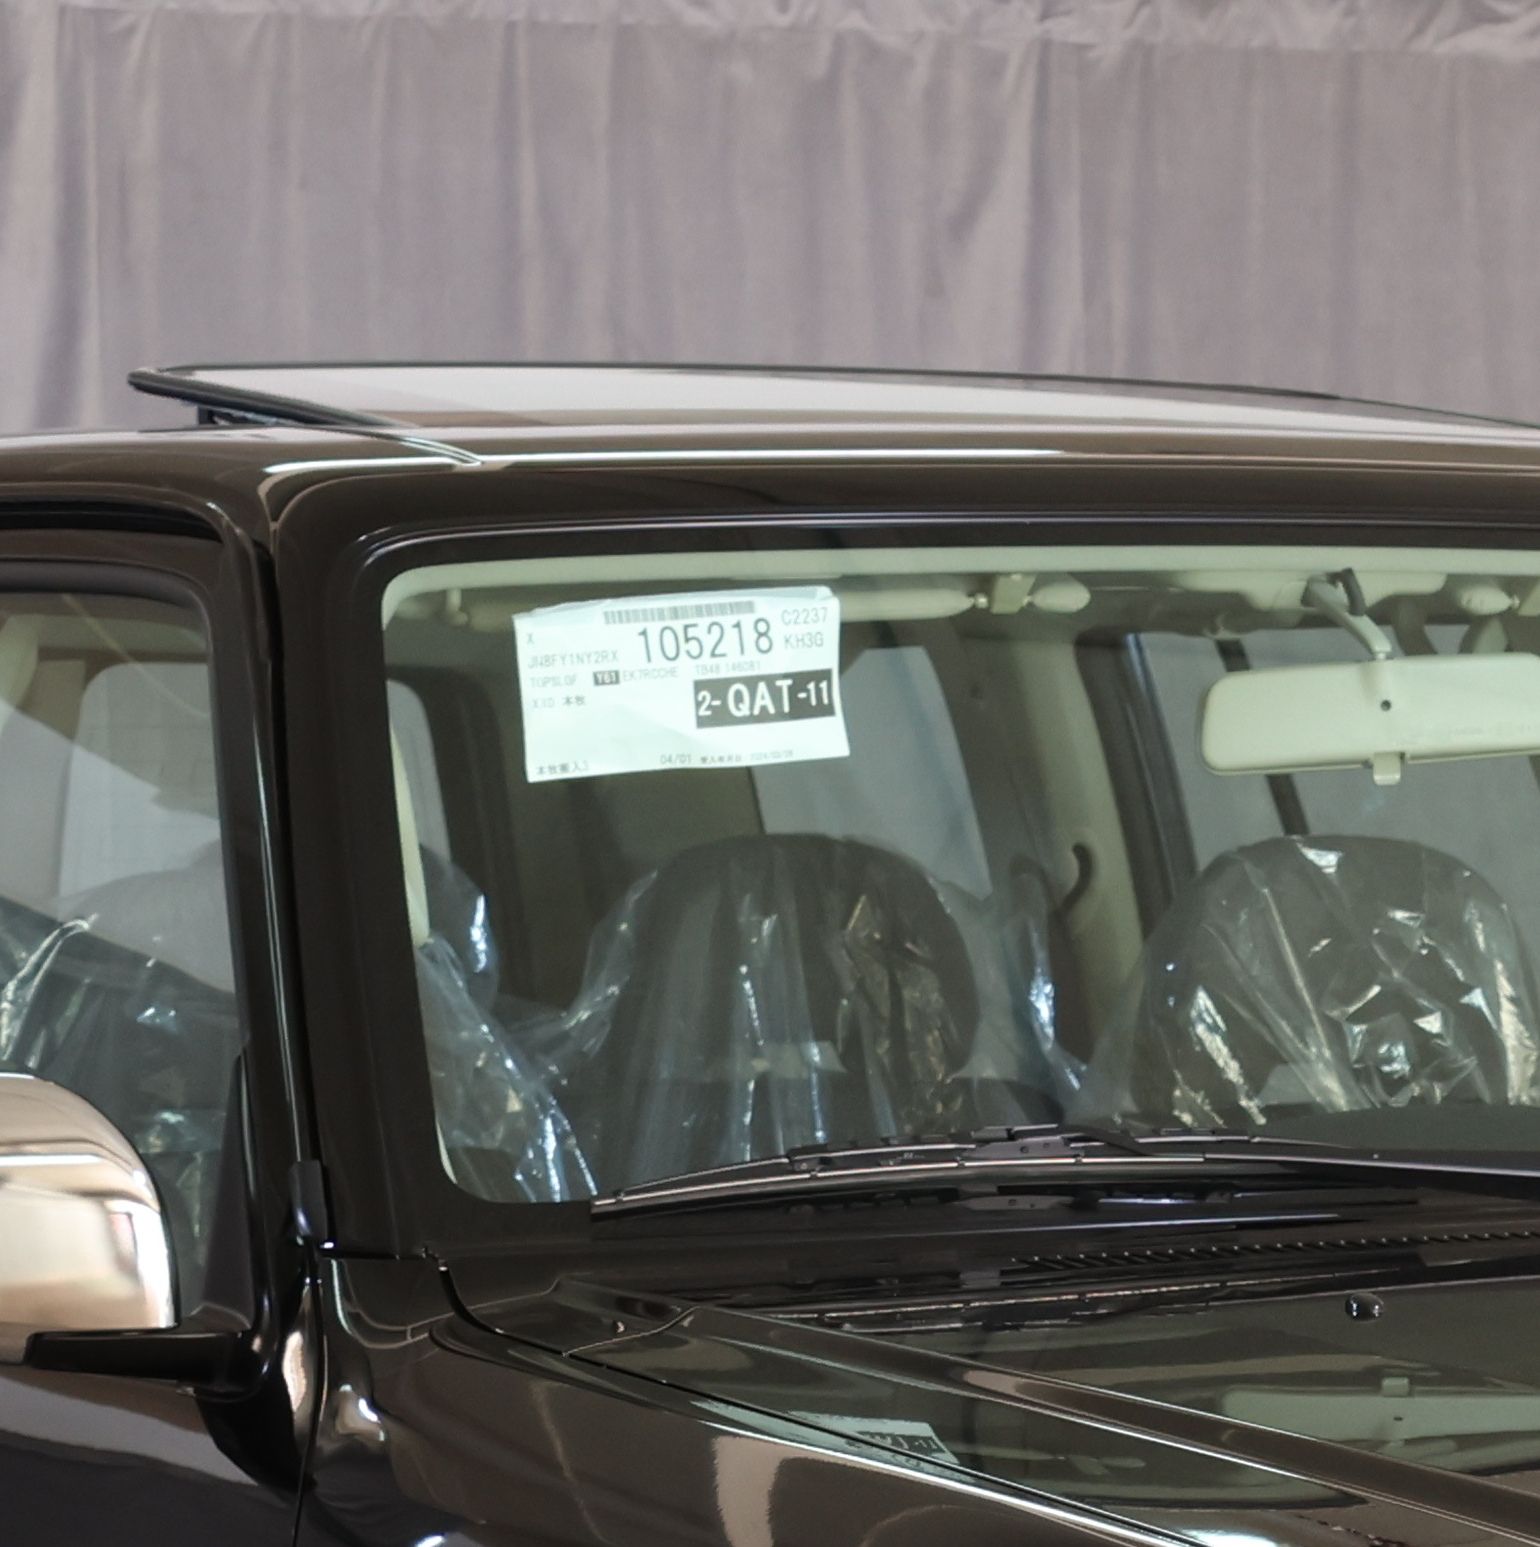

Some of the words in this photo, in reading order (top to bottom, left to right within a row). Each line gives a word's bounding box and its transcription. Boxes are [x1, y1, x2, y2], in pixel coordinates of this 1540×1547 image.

[780, 606, 828, 626] C2237
[637, 617, 774, 664] 105218
[783, 631, 825, 649] KH3G
